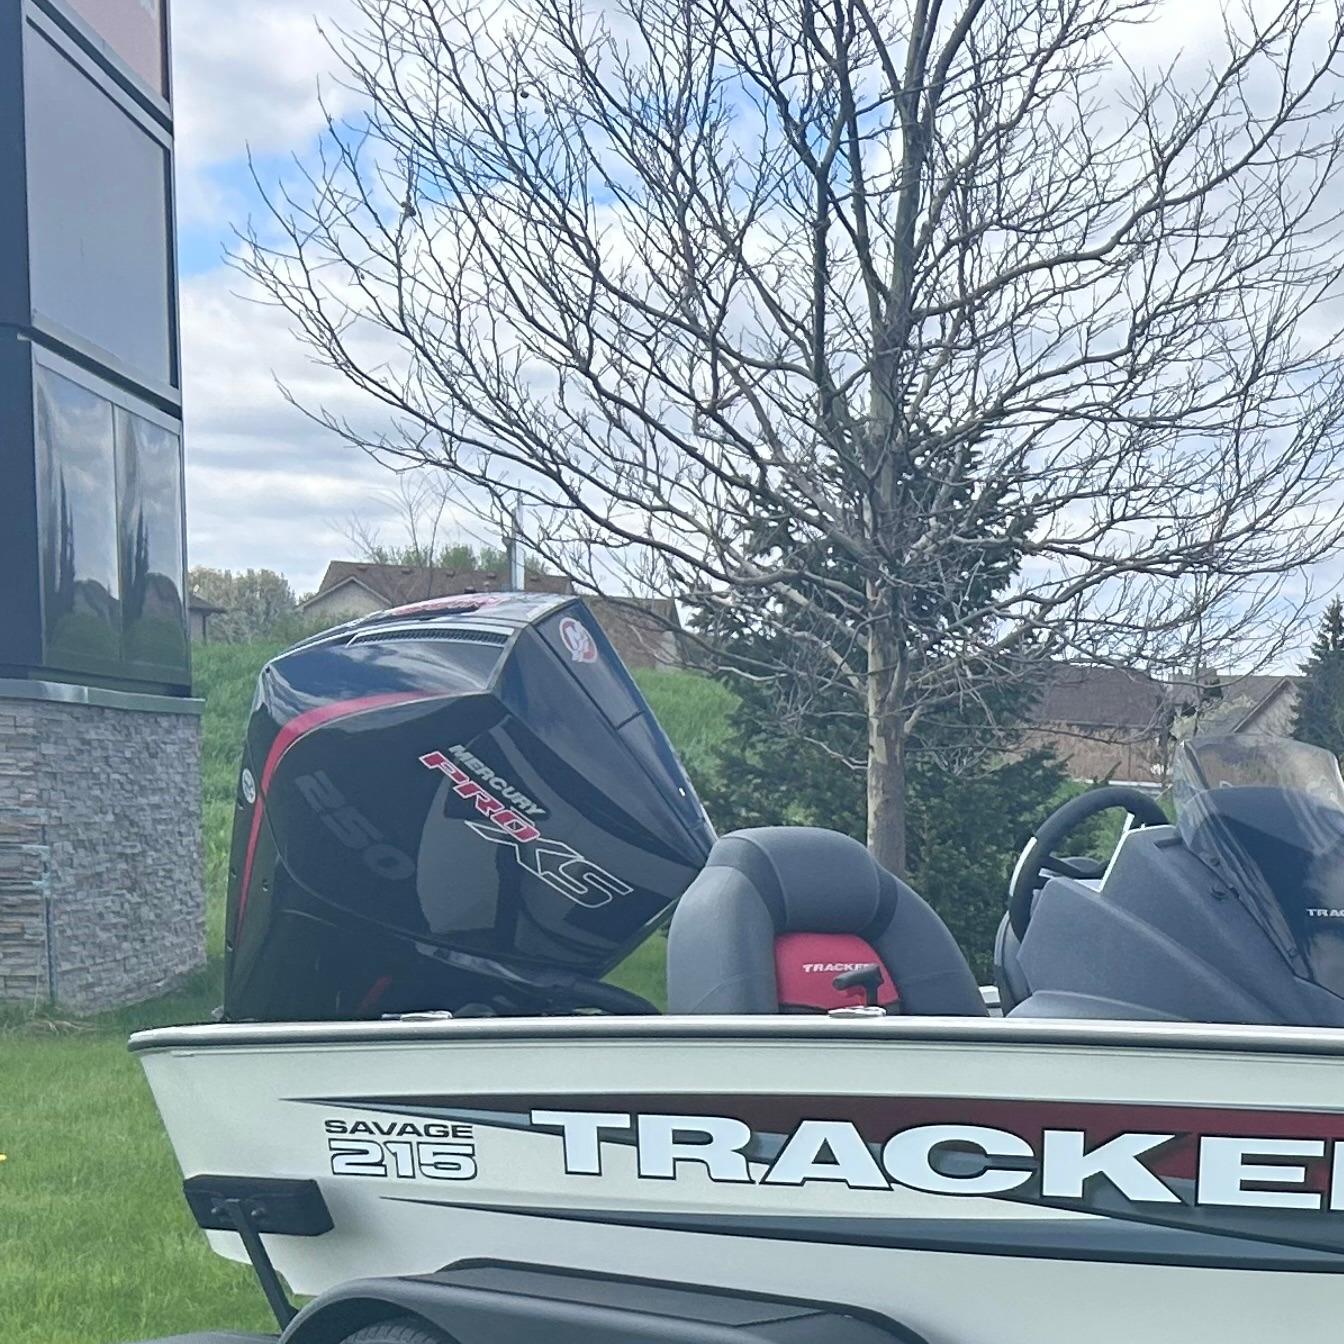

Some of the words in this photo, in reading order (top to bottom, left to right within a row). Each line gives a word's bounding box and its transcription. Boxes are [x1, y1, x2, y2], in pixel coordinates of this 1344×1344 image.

[418, 750, 542, 844] PRO
[449, 744, 546, 816] MERCURY
[294, 768, 417, 881] 250
[463, 818, 635, 910] XS
[802, 962, 870, 973] TRACKE
[324, 1119, 475, 1139] SAVAGE
[328, 1137, 478, 1181] 215
